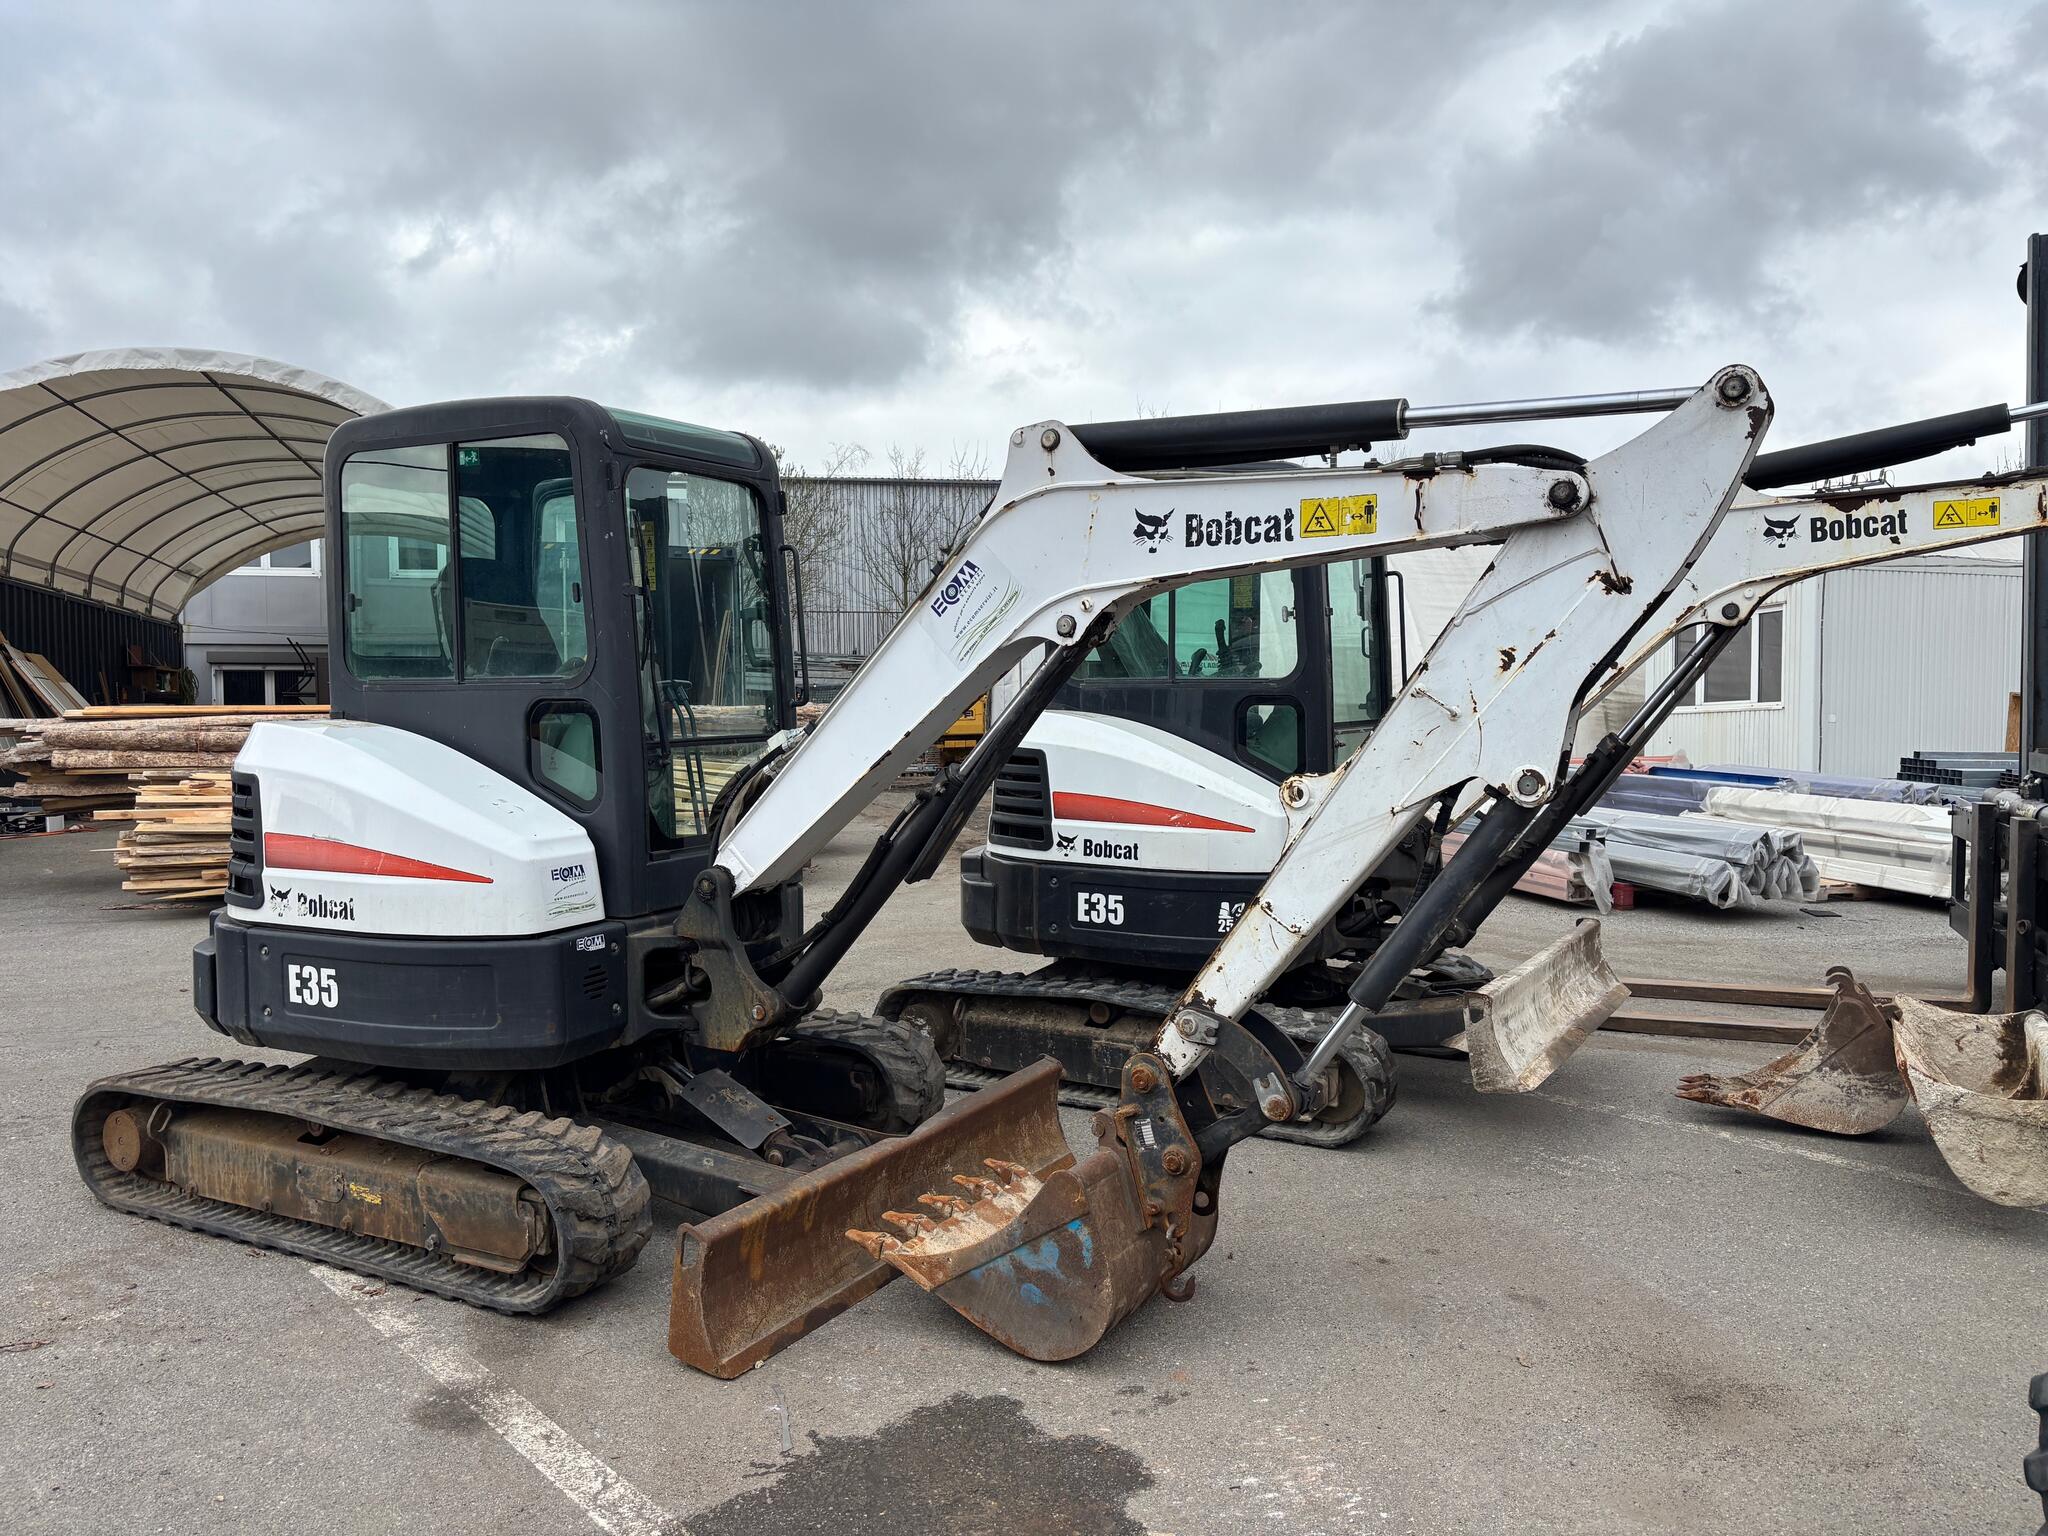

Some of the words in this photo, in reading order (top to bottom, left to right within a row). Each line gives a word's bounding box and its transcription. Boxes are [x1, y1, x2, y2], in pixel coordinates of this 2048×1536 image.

[1185, 507, 1295, 548] Bobcat
[1810, 508, 1908, 543] Bobcat
[1083, 838, 1139, 861] Bobcat
[297, 891, 356, 921] Bobcat
[1077, 891, 1125, 926] E35
[287, 963, 339, 1009] E35
